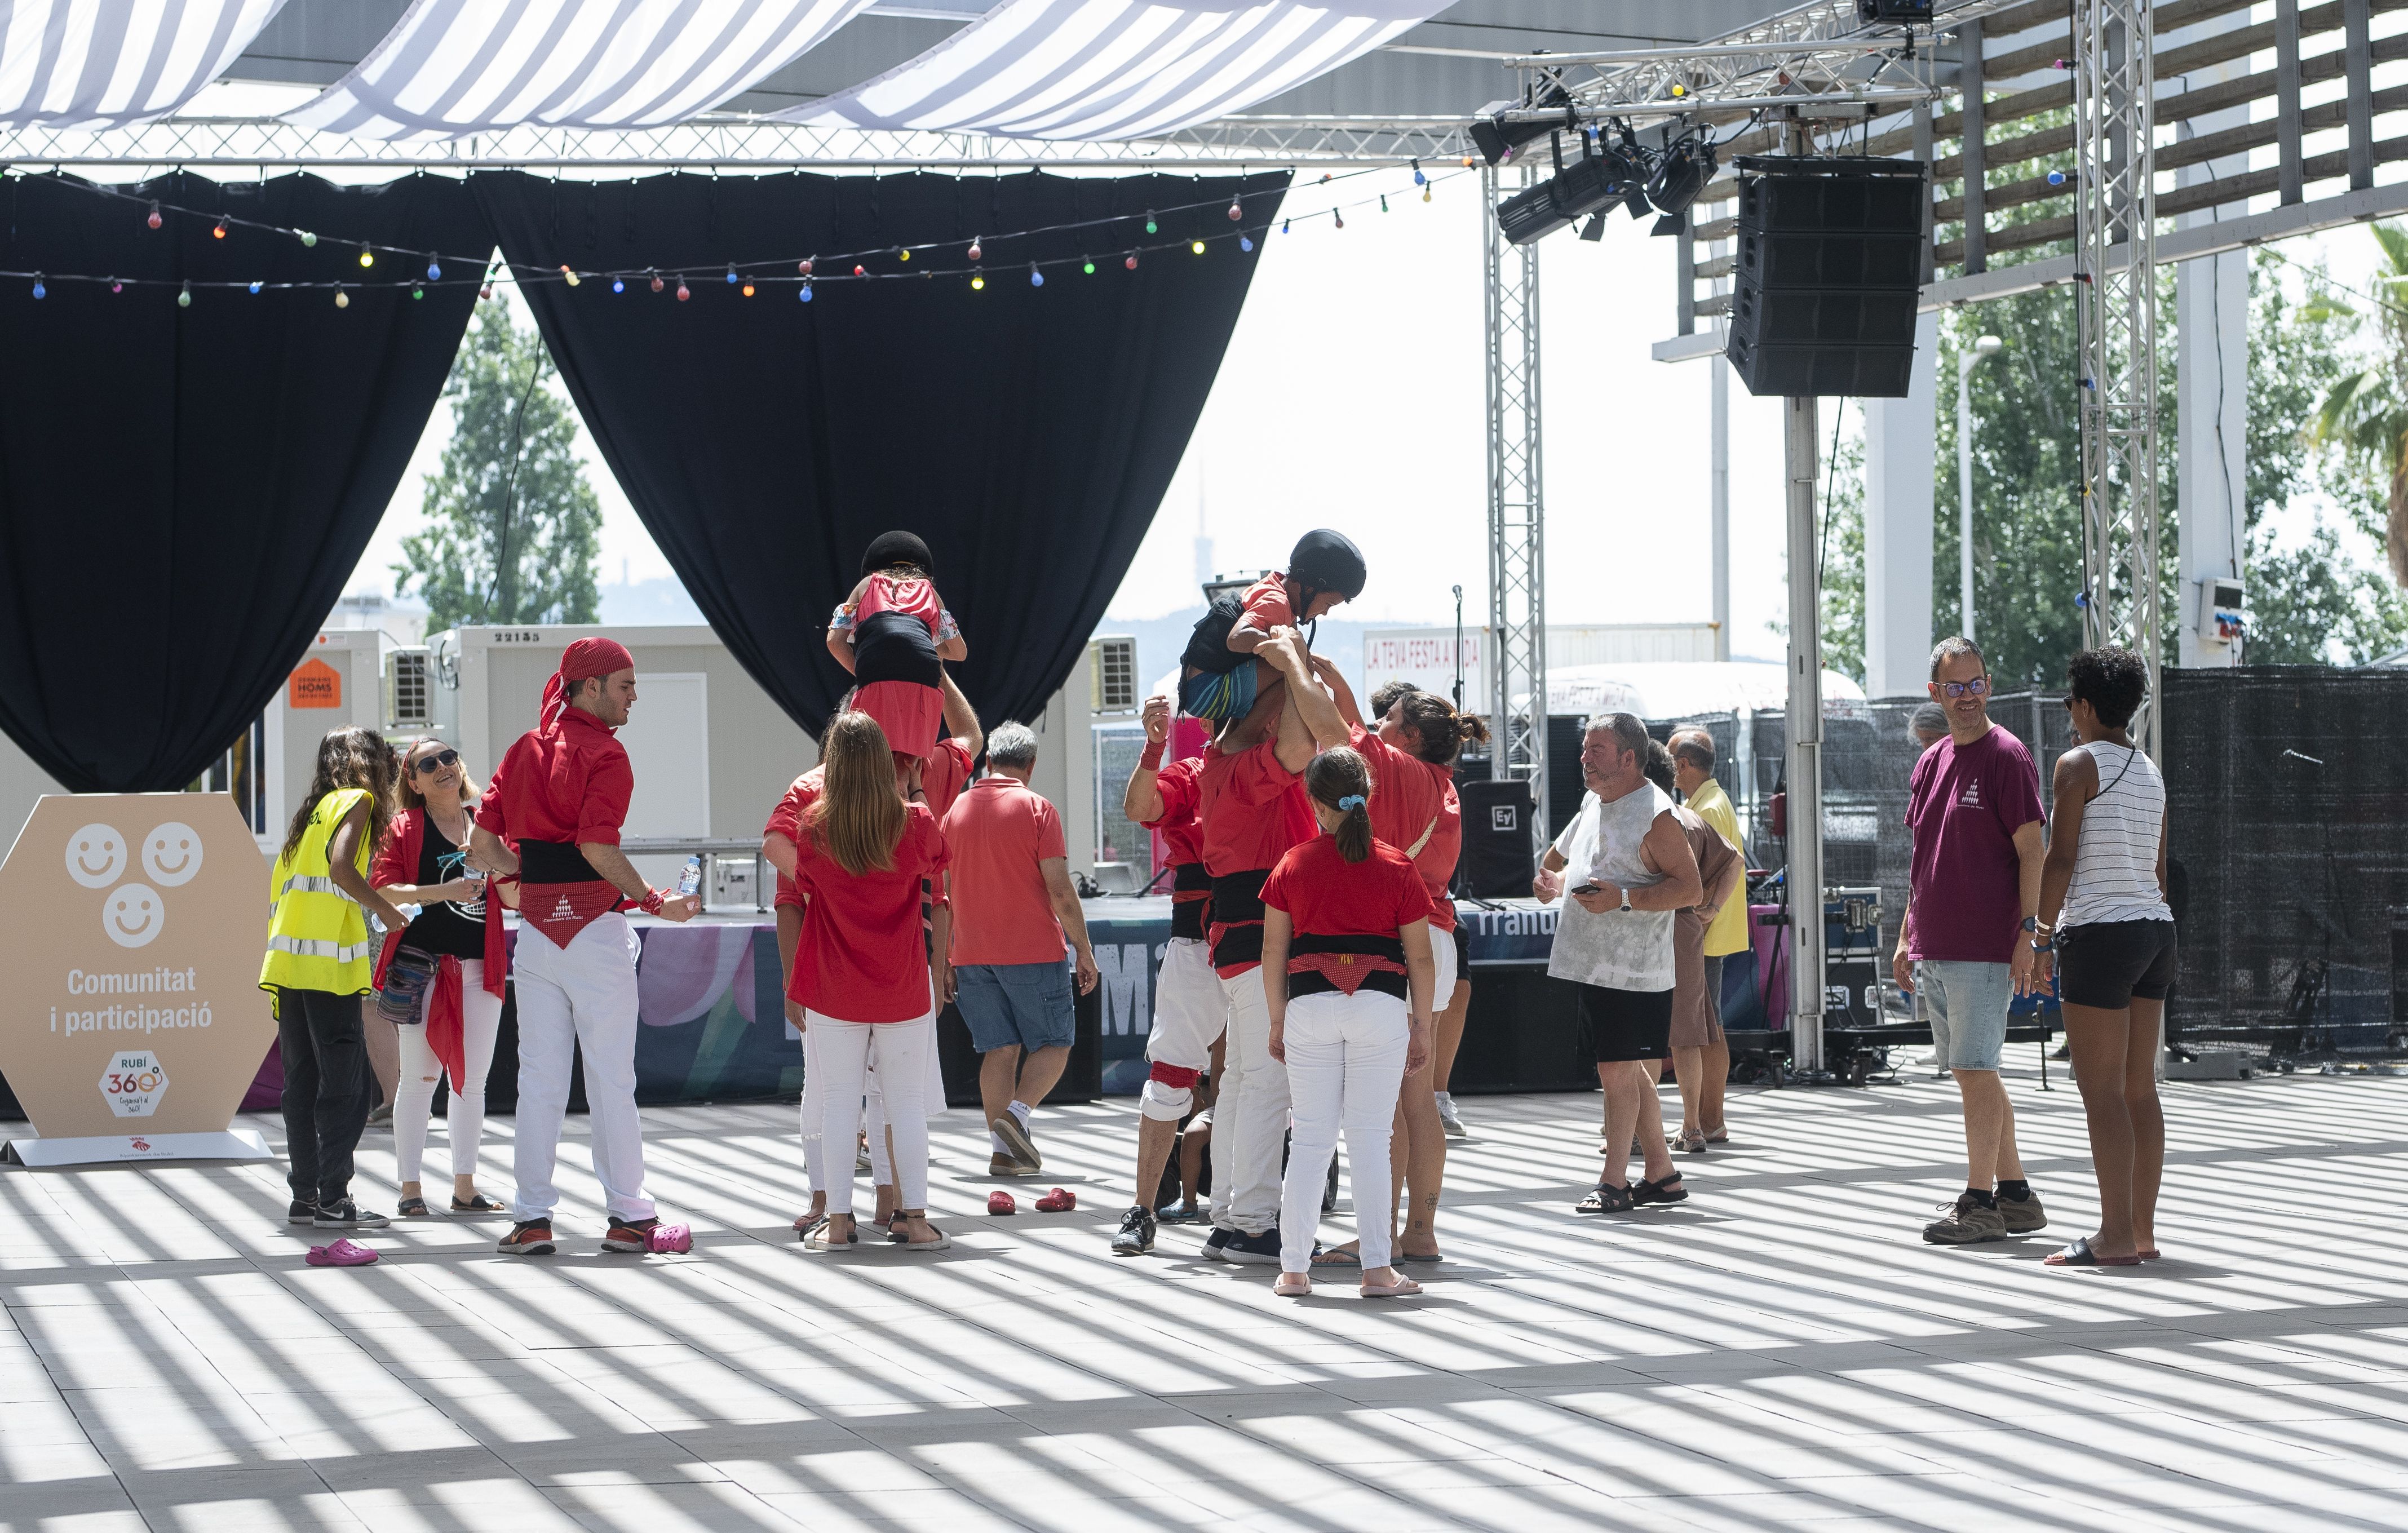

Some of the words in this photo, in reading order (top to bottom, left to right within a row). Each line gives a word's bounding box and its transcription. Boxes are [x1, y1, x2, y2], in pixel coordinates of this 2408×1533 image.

[1383, 641, 1408, 669] TEVA
[1410, 640, 1442, 668] FESTA
[1479, 911, 1559, 936] rrand
[68, 967, 196, 995] Comunitat
[50, 1006, 57, 1033] i
[65, 1002, 213, 1036] participació
[121, 1056, 147, 1068] RUBÍ
